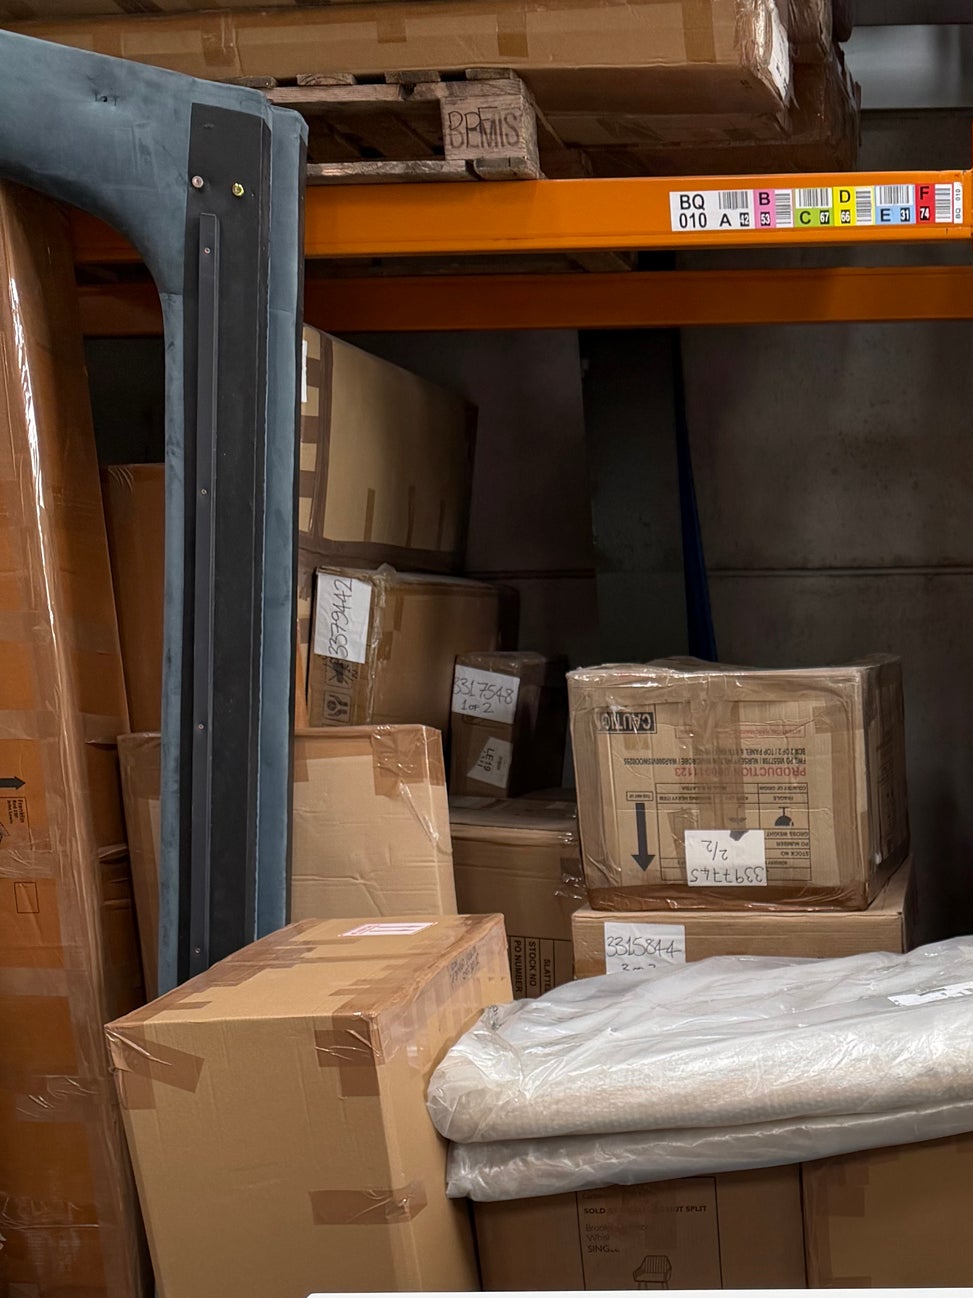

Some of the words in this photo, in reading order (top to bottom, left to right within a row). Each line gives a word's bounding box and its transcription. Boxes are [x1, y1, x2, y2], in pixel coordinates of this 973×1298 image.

[759, 192, 770, 205] B
[840, 190, 851, 203] D
[920, 186, 930, 200] F
[680, 194, 705, 210] BQ
[680, 213, 707, 228] 010
[720, 214, 732, 227] A
[800, 211, 811, 224] C
[881, 208, 891, 222] E
[900, 208, 910, 221] 31
[920, 206, 930, 221] 74
[328, 578, 352, 659] 3379442
[482, 702, 494, 713] 2
[690, 866, 764, 884] 3397745
[529, 941, 537, 971] STOCK
[515, 954, 523, 993] NUMBER
